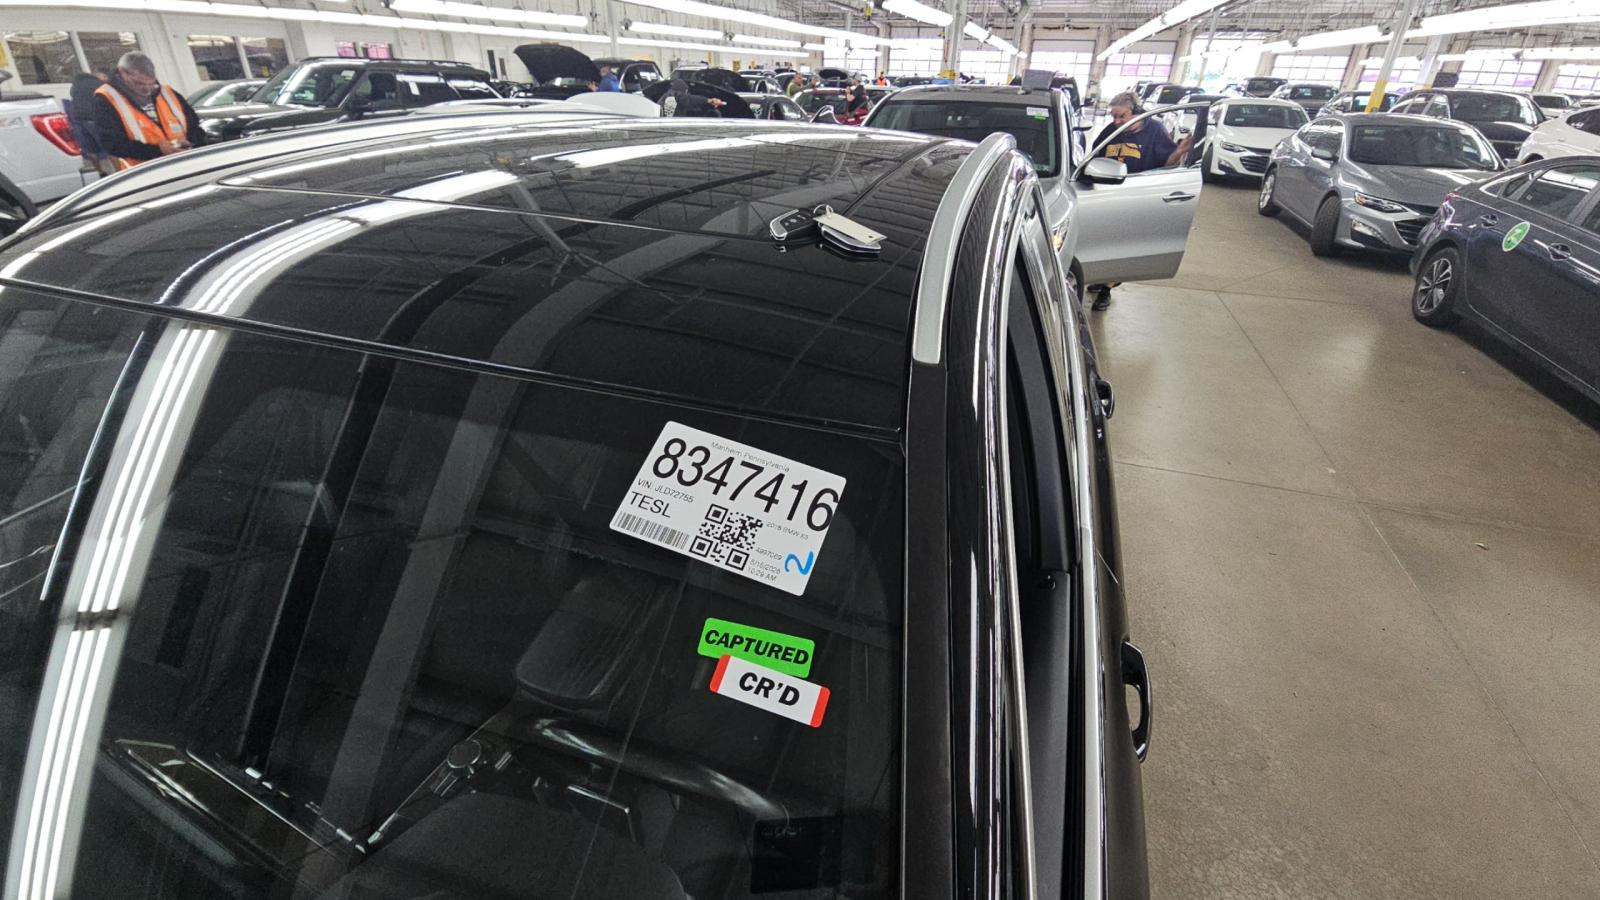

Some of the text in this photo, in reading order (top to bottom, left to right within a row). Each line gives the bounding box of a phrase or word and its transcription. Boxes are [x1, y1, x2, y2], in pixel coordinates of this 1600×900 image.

[710, 441, 790, 472] Manheim Pennsylvania
[653, 437, 839, 532] 8347416
[629, 491, 672, 517] TESL
[782, 526, 800, 537] BMW
[765, 573, 777, 582] AM
[704, 629, 810, 665] CAPTURED
[739, 672, 800, 706] CR'D
